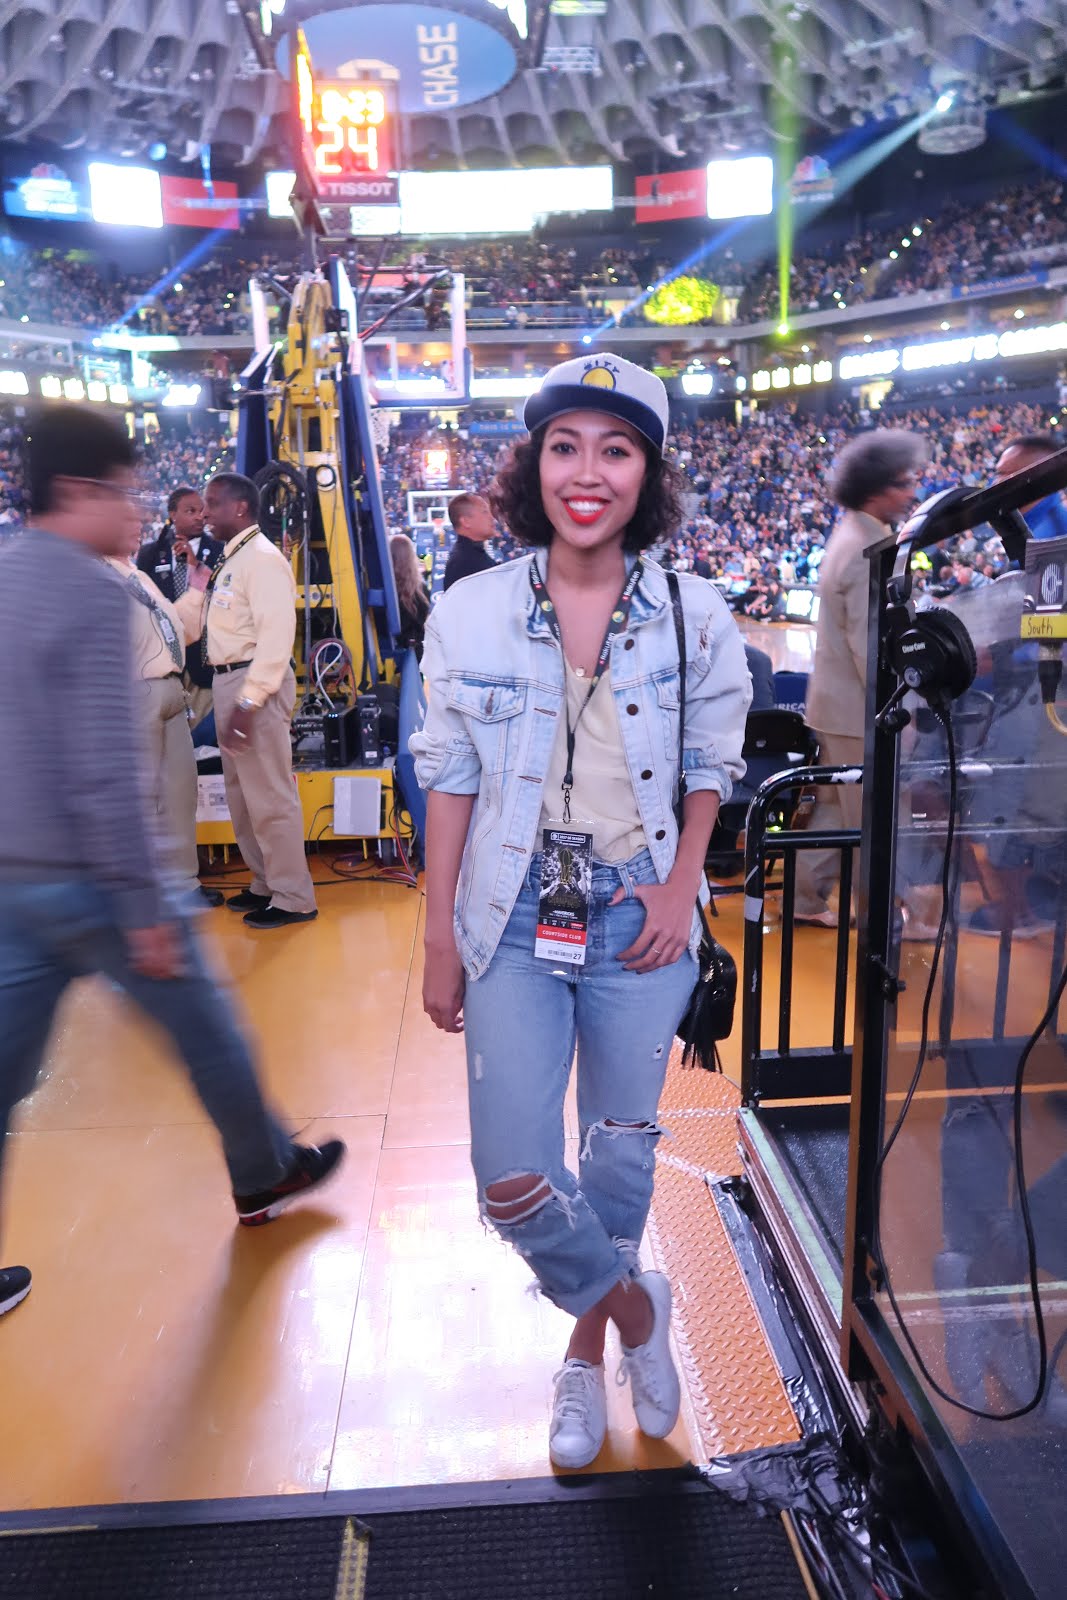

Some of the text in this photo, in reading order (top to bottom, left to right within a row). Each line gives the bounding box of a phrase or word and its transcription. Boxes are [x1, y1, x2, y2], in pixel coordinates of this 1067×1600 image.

[416, 22, 460, 106] CHASE
[316, 123, 378, 173] 24
[328, 182, 394, 195] TISSOT
[623, 571, 641, 596] Rakuten
[1027, 618, 1053, 635] South
[601, 632, 616, 660] Rakuten
[542, 930, 568, 939] COURTSIDE
